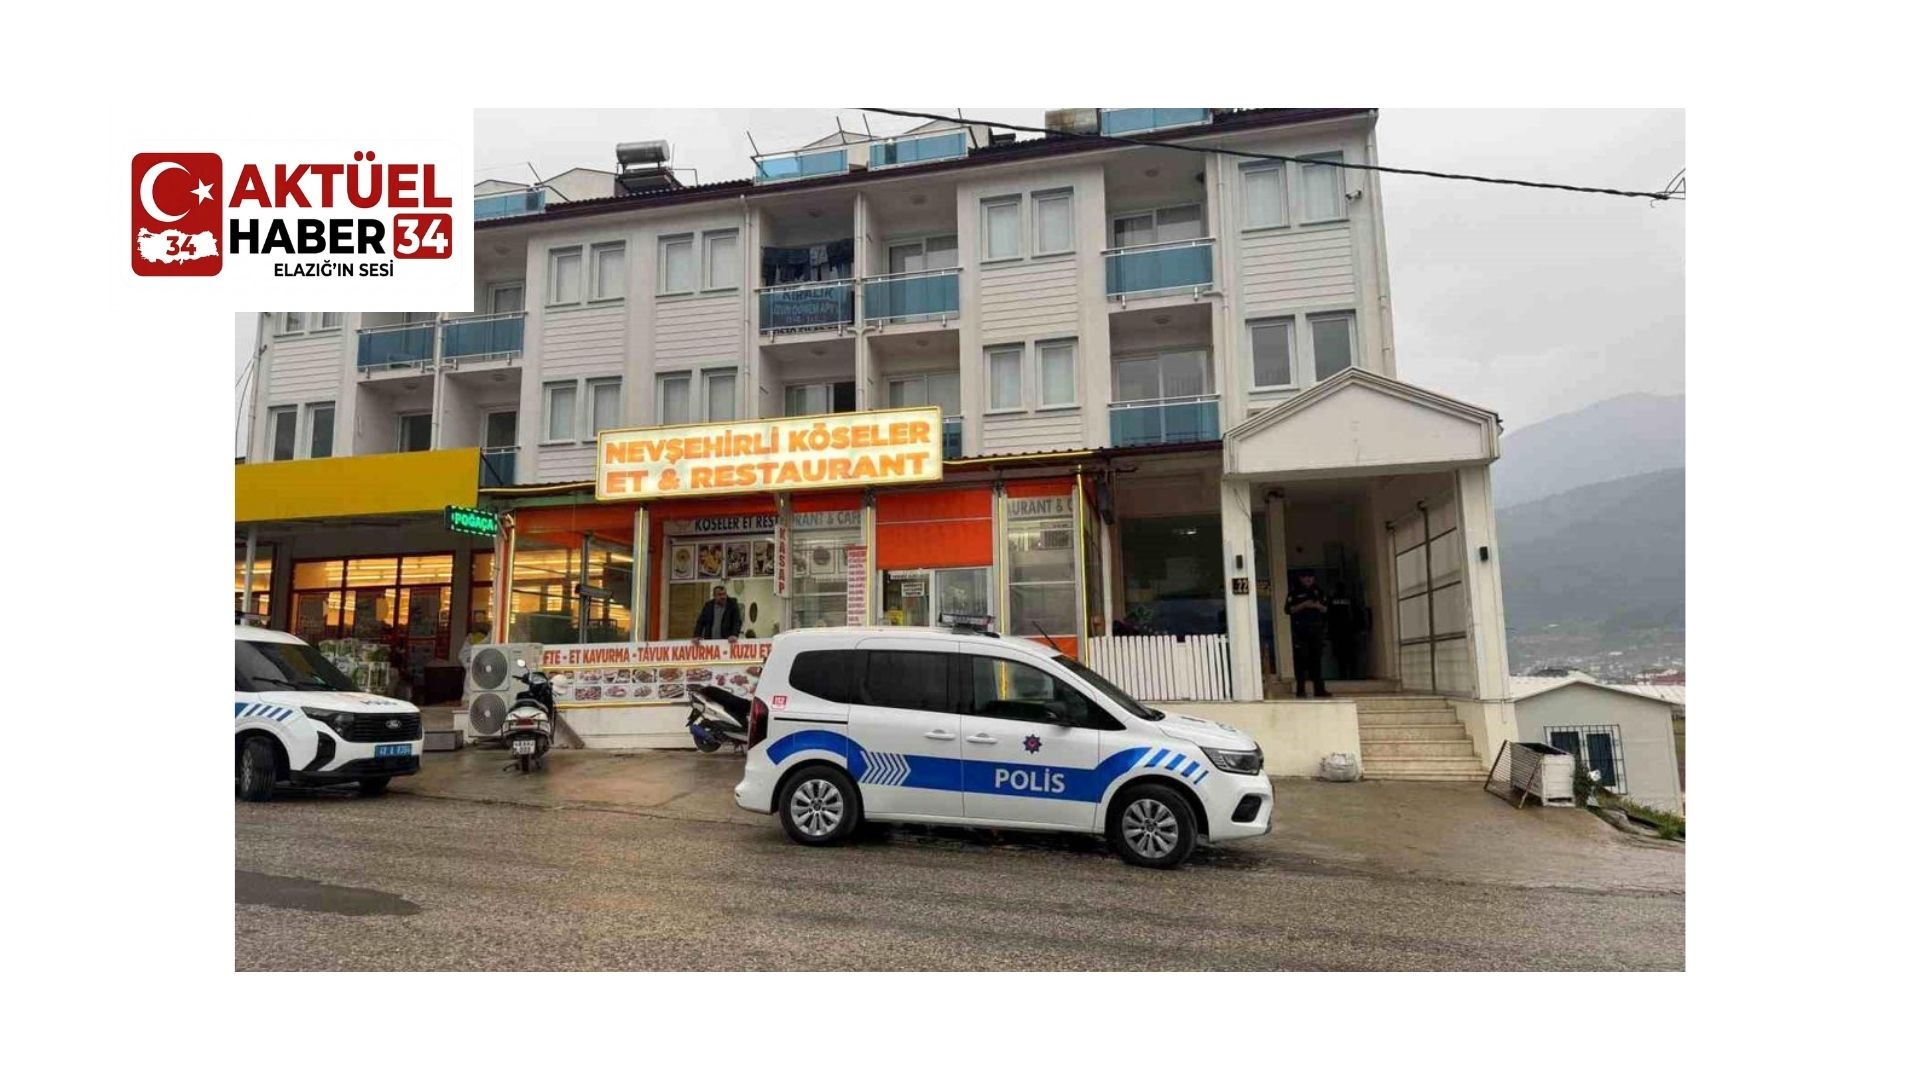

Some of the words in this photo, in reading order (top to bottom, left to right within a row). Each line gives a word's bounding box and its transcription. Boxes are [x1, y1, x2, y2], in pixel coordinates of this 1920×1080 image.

[605, 427, 779, 464] NEVŞEHİRLİ
[788, 421, 931, 453] KÖSELER
[606, 470, 649, 494] ET
[657, 468, 680, 491] &
[690, 452, 929, 489] RESTAURANT
[455, 512, 494, 531] POĞAÇA
[778, 527, 786, 594] KASAP
[569, 649, 580, 664] ET
[582, 648, 630, 664] KAVURMA
[638, 646, 669, 662] TAVUK
[671, 644, 720, 661] KAVURMA
[730, 643, 757, 659] KUZU
[995, 768, 1066, 793] POLİS
